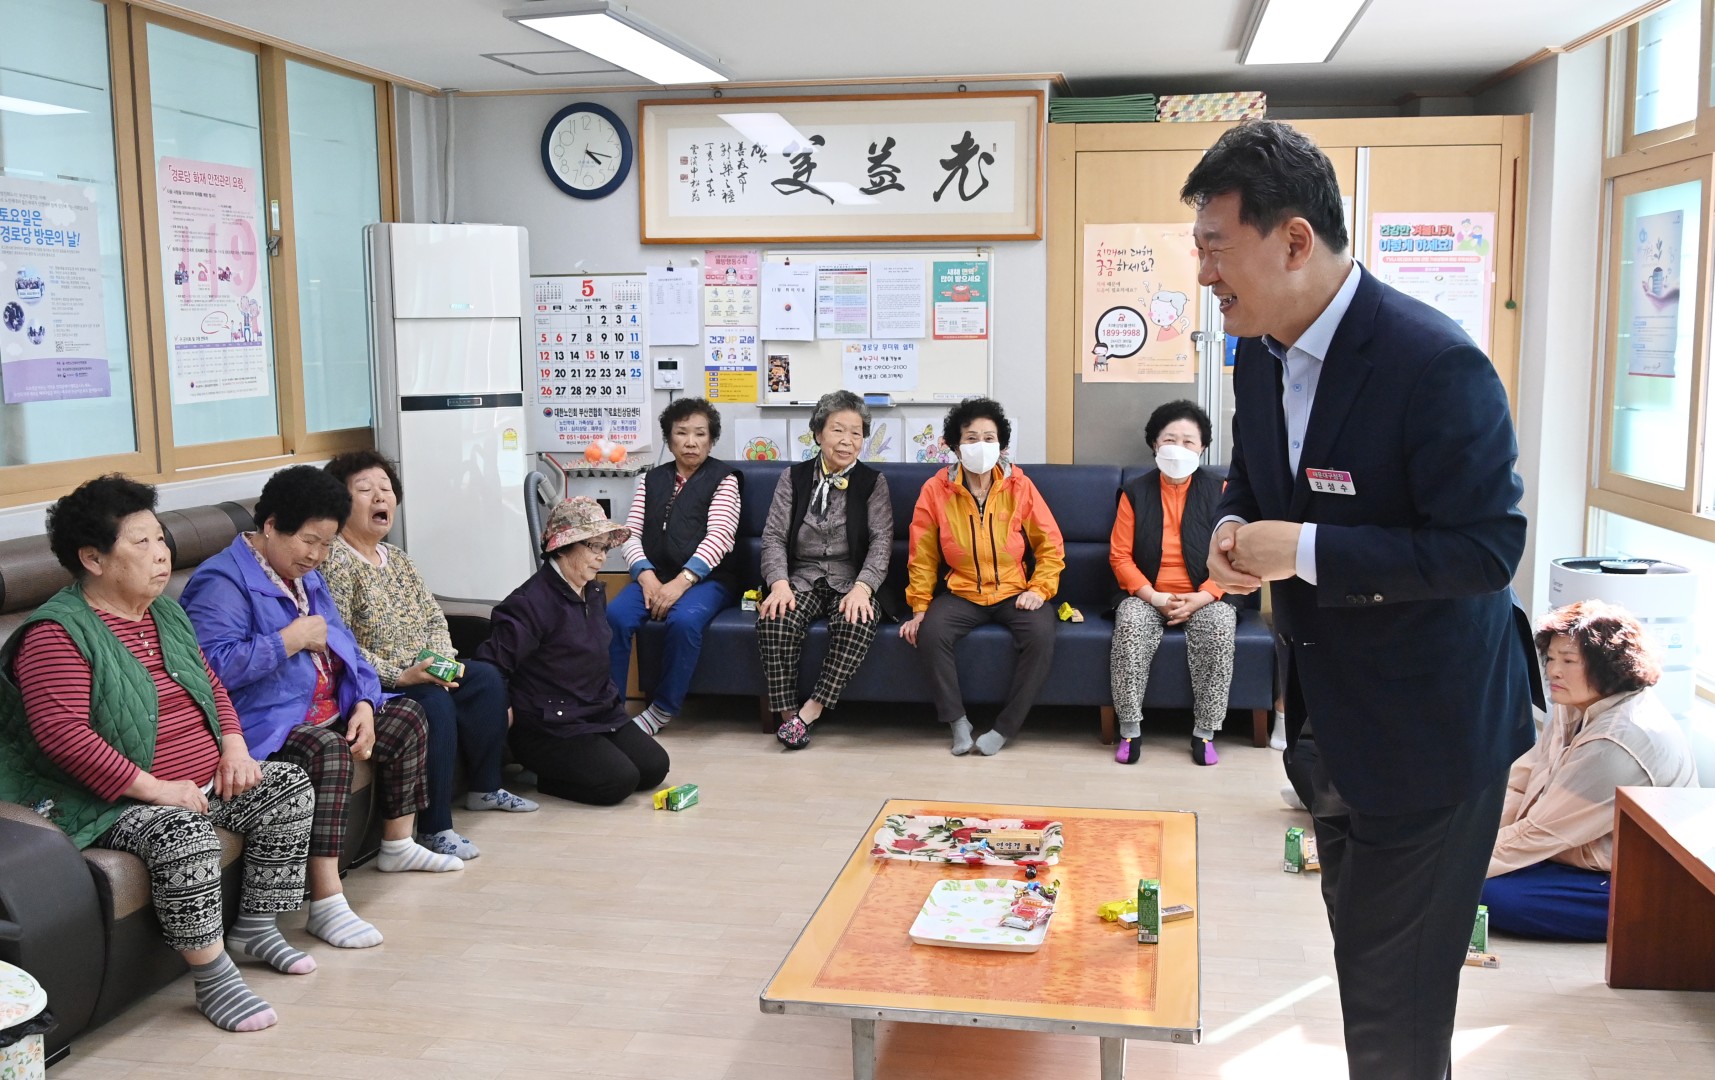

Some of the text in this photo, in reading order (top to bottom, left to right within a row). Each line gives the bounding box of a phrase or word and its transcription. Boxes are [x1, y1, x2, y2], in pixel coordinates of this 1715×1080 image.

[568, 120, 576, 134] 11
[582, 115, 591, 130] 12
[558, 130, 574, 146] 10
[607, 128, 614, 143] 2
[554, 145, 564, 160] 9
[614, 144, 620, 158] 3
[560, 159, 570, 174] 8
[608, 160, 615, 172] 4
[193, 171, 206, 184] 화재
[208, 173, 232, 188] 안전관리
[572, 170, 578, 184] 7
[583, 172, 594, 187] 6
[599, 169, 606, 183] 5
[0, 208, 42, 227] 토요일은
[0, 226, 80, 248] 경로당 방문의 날!
[1380, 224, 1411, 237] 건강한
[1096, 242, 1152, 258] 치매에 대해
[1379, 239, 1414, 252] 이렇게
[1096, 258, 1154, 276] 궁금하세요?
[582, 280, 594, 297] 5
[587, 315, 636, 324] 1 2 3 4
[542, 333, 638, 342] 5 6 7 8 9 10 11
[709, 336, 755, 344] 건강UP 교실
[1102, 329, 1140, 337] 1899-9988
[540, 350, 640, 360] 12 13 14 15 16 17 18
[541, 368, 641, 378] 19 20 21 22 23 24 25
[541, 386, 626, 395] 26 27 28 29 30 31
[554, 408, 578, 417] 대한노인회
